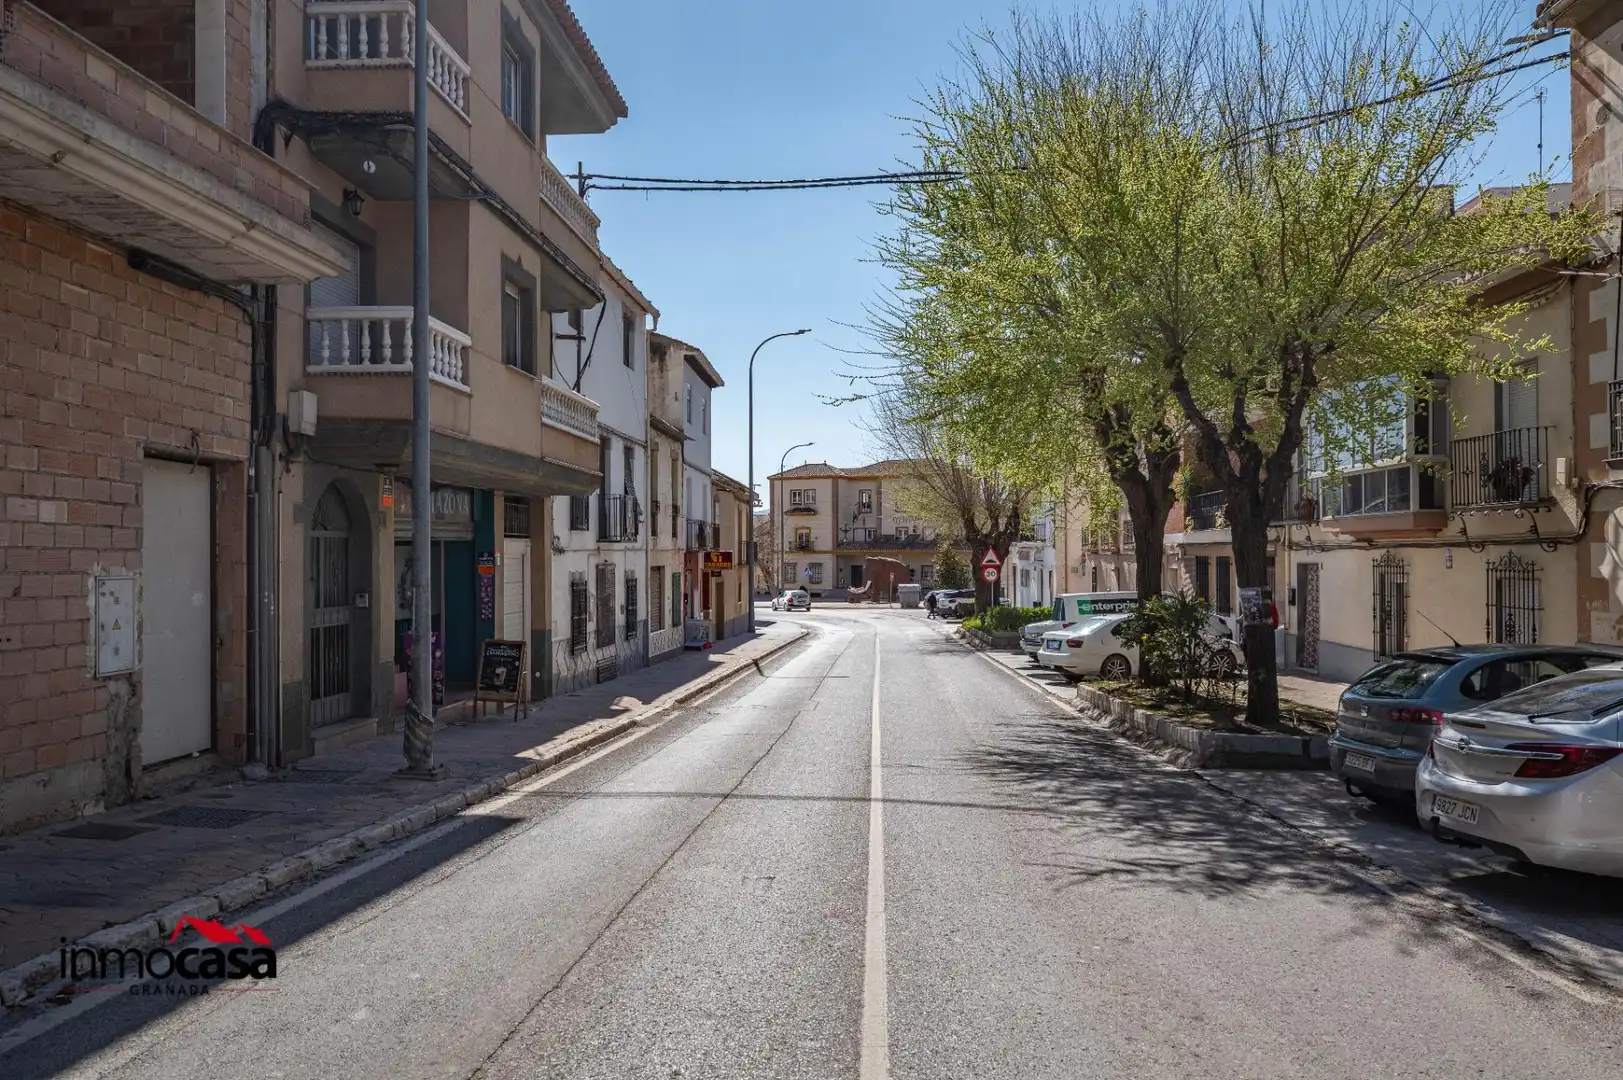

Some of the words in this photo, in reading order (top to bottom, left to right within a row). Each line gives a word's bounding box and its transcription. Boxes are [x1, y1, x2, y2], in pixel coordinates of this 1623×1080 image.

[985, 570, 996, 578] 30
[1436, 797, 1457, 814] 9827
[1458, 803, 1478, 821] JCN
